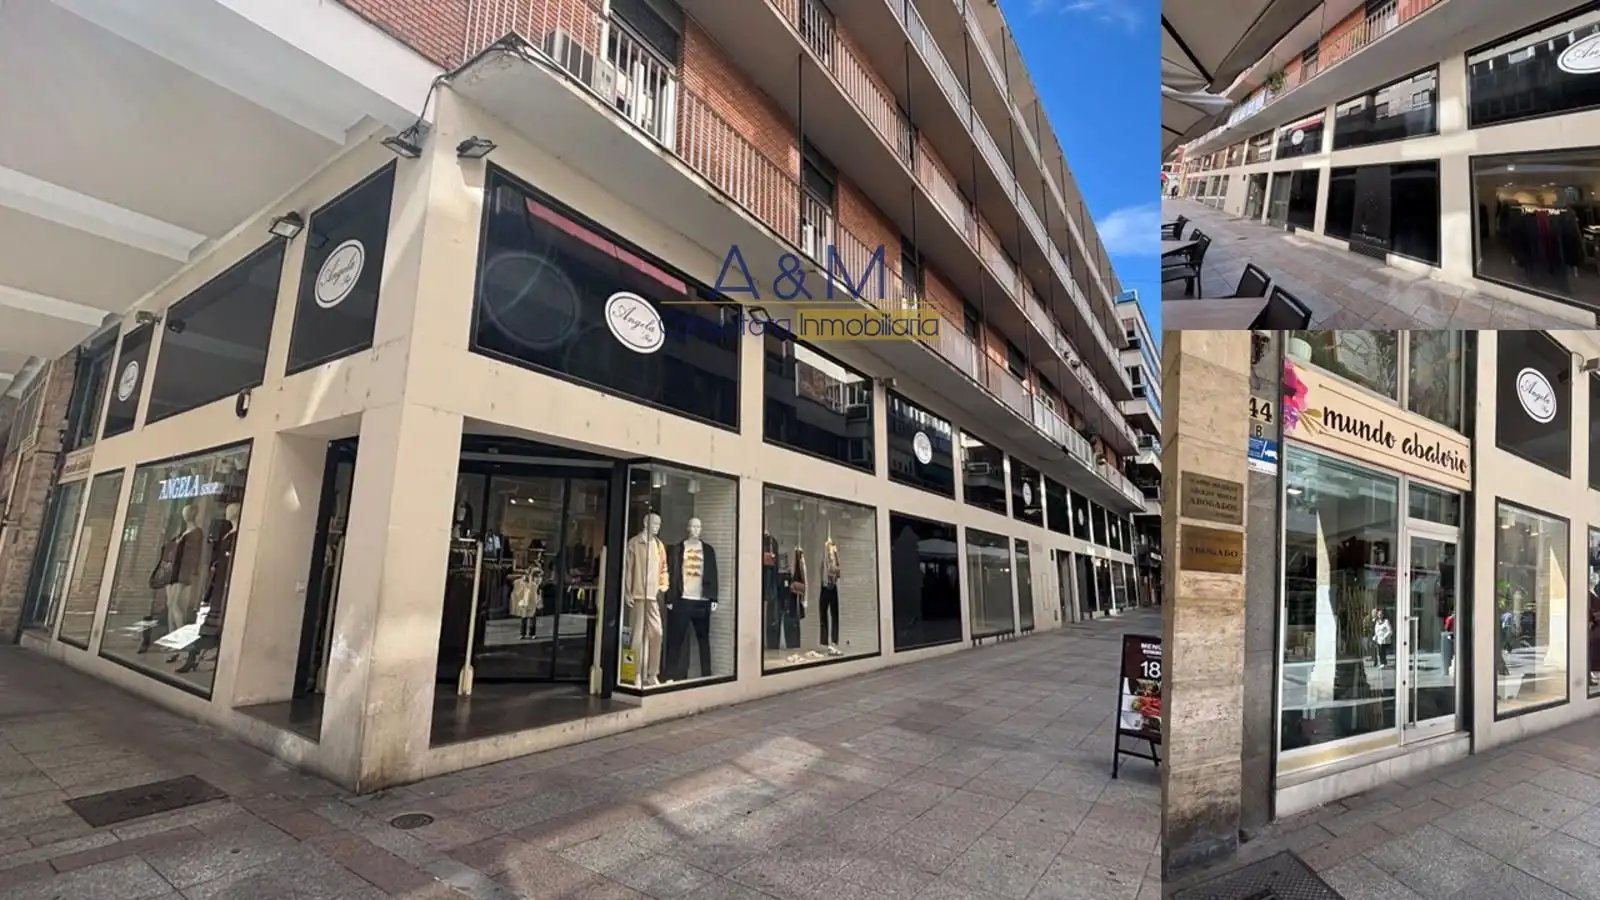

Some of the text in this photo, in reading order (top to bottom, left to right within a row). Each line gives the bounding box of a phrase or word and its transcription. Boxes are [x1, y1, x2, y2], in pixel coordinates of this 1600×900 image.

[612, 303, 656, 333] Angela
[1249, 396, 1273, 423] 44
[1323, 406, 1468, 474] mundo abalorio
[1140, 660, 1161, 678] 18
